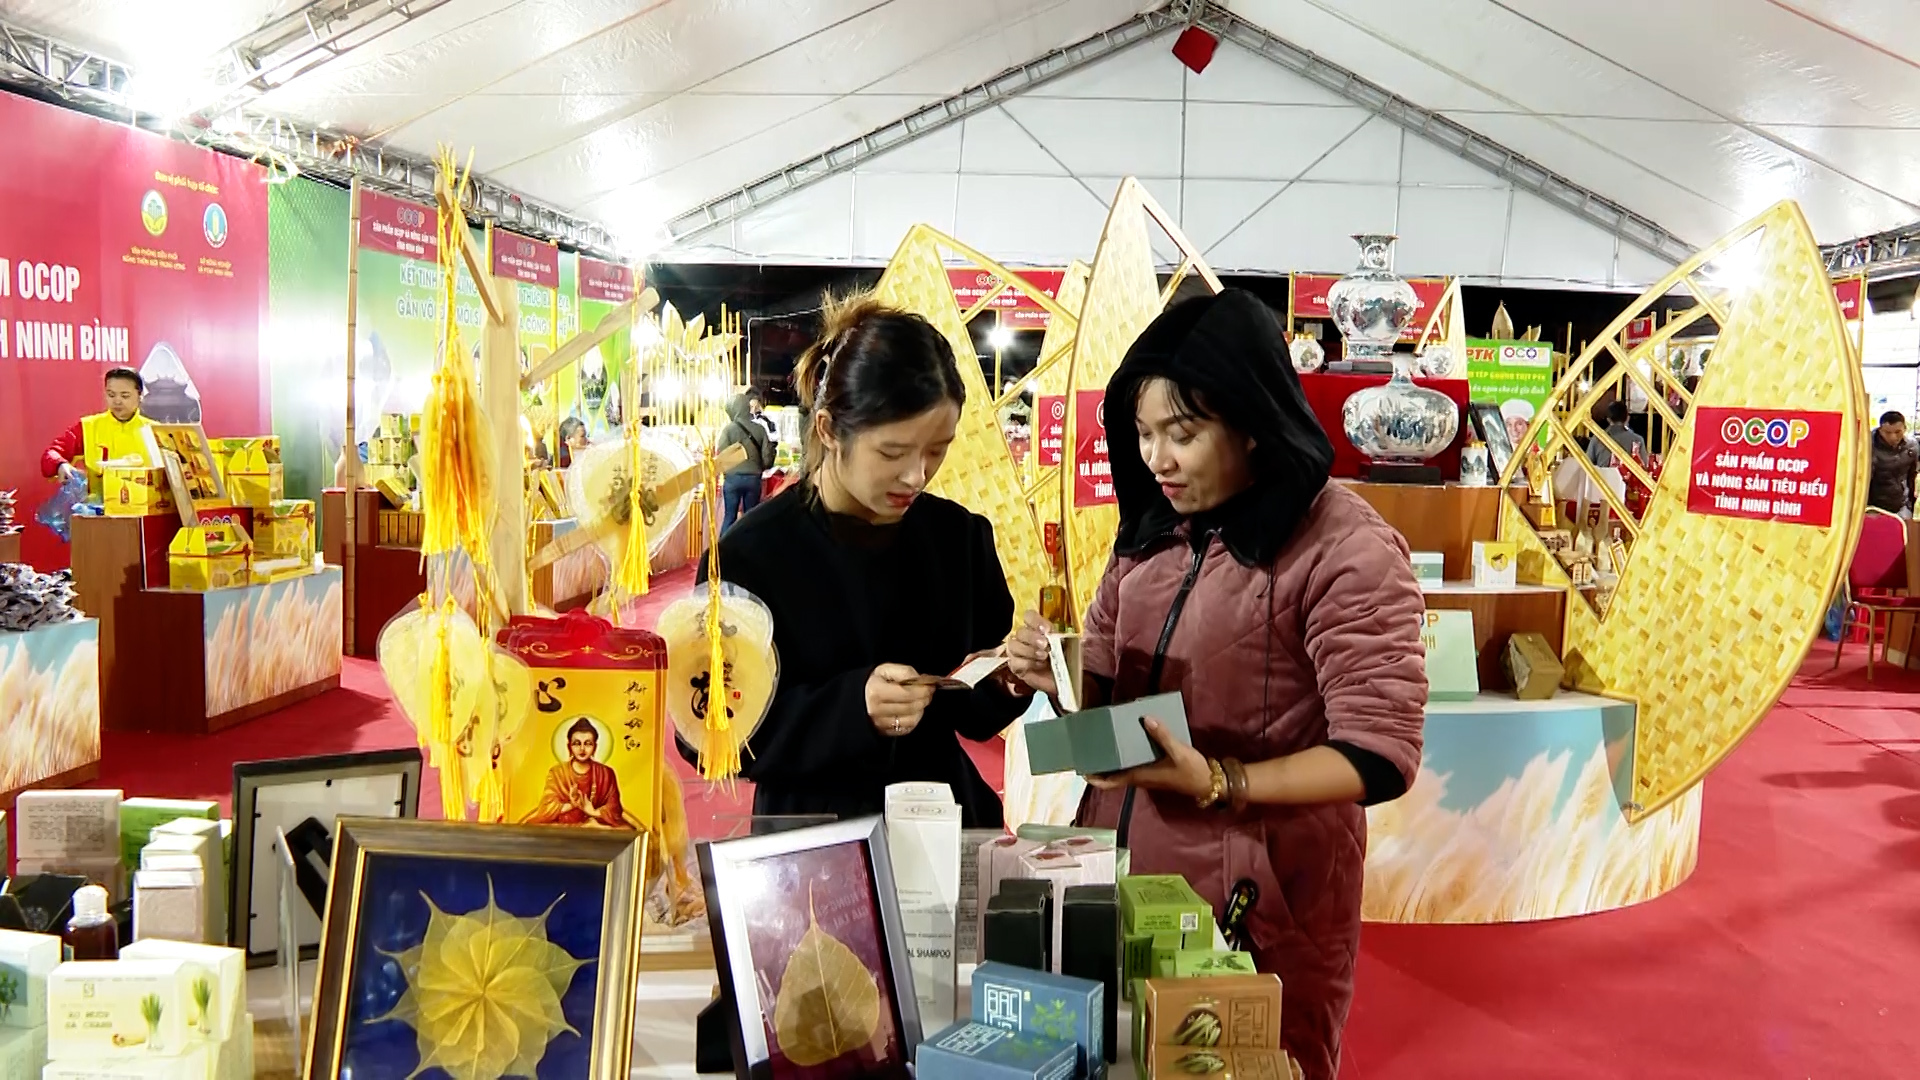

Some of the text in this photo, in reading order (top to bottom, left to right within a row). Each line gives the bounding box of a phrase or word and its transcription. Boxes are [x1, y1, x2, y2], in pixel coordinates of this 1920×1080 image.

[18, 260, 80, 303] OCOP
[16, 320, 74, 360] NINH
[80, 317, 129, 362] BÌNH
[1504, 347, 1547, 360] OCOP
[1721, 416, 1810, 448] OCOP
[1080, 459, 1090, 476] VÀ
[1715, 450, 1809, 474] SẢN PHẨM OCOP
[1695, 471, 1828, 497] VÀ NÔNG SẢN TIÊU BIỂU
[1714, 492, 1802, 516] TỈNH NINH BÌNH
[917, 948, 951, 959] SHAMPOO
